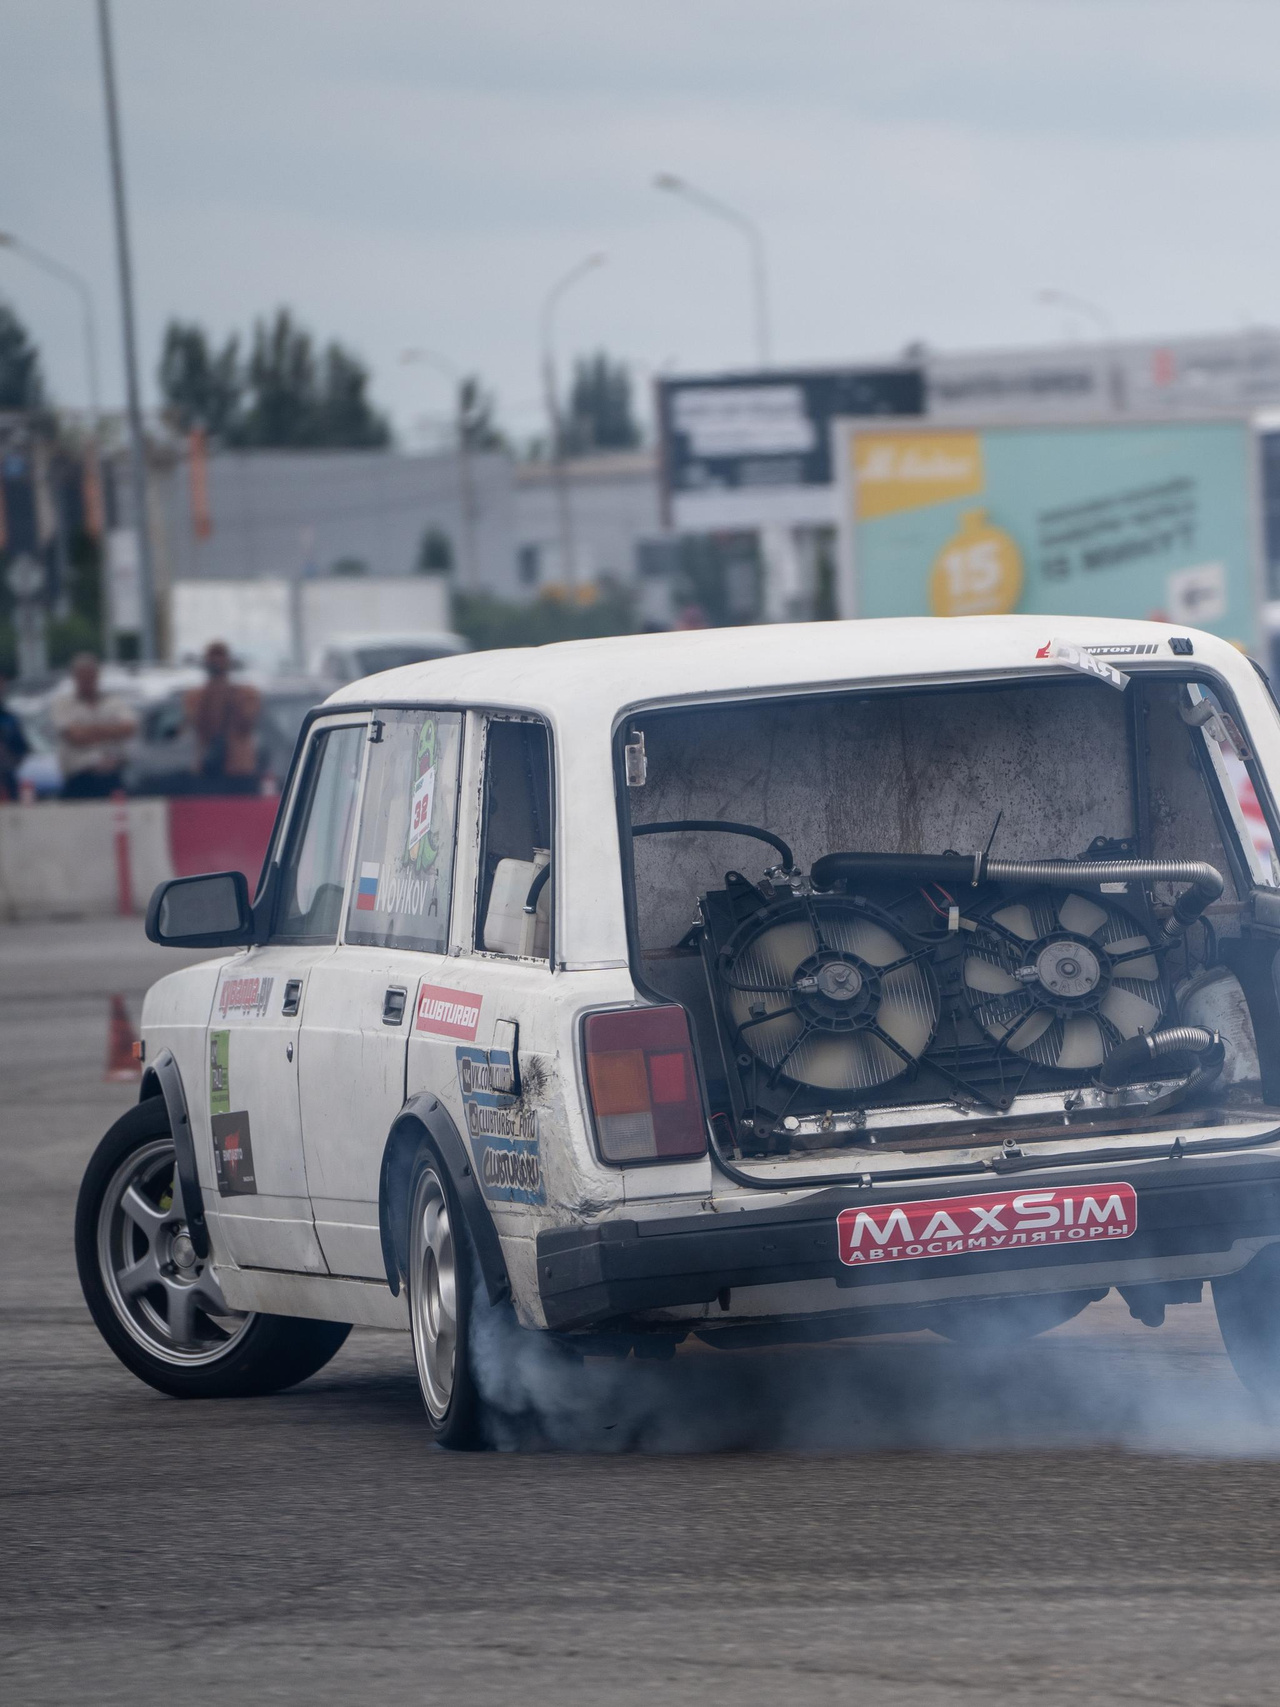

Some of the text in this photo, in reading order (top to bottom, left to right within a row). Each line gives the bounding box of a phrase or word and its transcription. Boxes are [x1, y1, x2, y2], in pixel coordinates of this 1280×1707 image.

[943, 543, 1000, 596] 15
[413, 793, 429, 830] 32
[375, 863, 428, 916] Novikov
[419, 997, 479, 1028] CLUBTURBO
[848, 1224, 1128, 1262] АВТОСИМУЛЯТОРЫ
